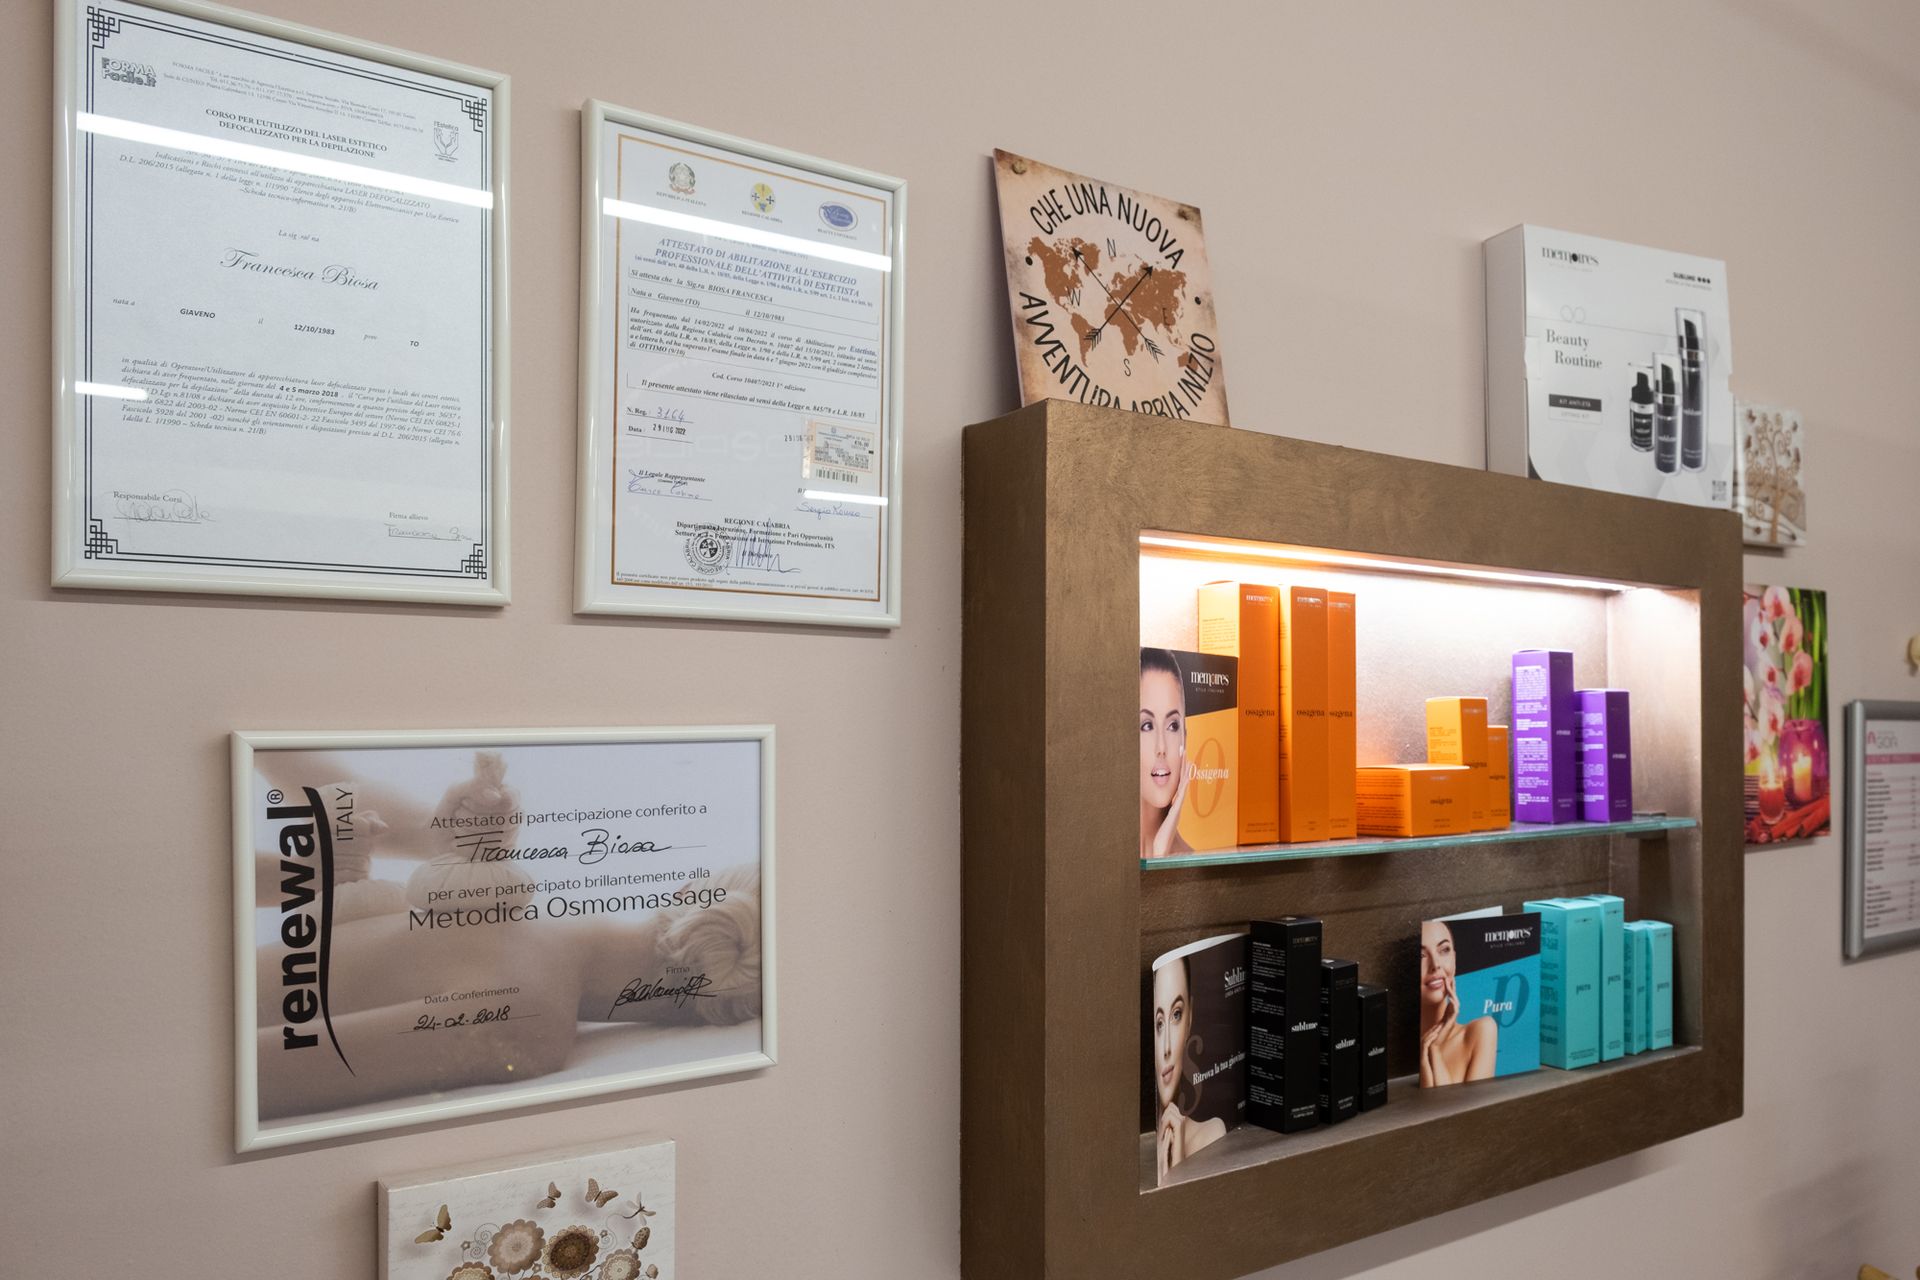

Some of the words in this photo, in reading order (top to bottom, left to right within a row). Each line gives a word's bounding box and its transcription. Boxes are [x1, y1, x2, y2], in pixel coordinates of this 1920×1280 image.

[102, 57, 156, 77] FORMA
[102, 69, 156, 87] Facile.it
[206, 109, 235, 120] CORSO
[238, 115, 253, 123] PER
[256, 119, 301, 133] L'UTILIZZO
[322, 132, 346, 142] LASER
[348, 137, 386, 150] ESTETICO
[219, 121, 288, 139] DEFOCALIZZATO
[292, 135, 306, 143] PER
[321, 141, 374, 157] DEPILAZIONE
[1030, 189, 1071, 235] CHE
[1064, 183, 1113, 218] UNA
[1117, 192, 1185, 270] NUOVA
[660, 238, 713, 255] ATTESTATO
[716, 249, 725, 258] DI
[728, 252, 790, 271] ABILITAZIONE
[1107, 238, 1117, 257] N
[220, 248, 316, 281] Francesca
[321, 264, 379, 290] Biosa
[655, 248, 732, 270] PROFESSIONALE
[804, 278, 812, 287] DI
[815, 281, 859, 296] ESTETISTA
[631, 287, 645, 295] Nata
[657, 292, 683, 302] Giaveno
[687, 280, 704, 288] Sig.ra
[708, 284, 730, 293] BIOSA
[732, 289, 772, 301] FRANCESCA
[180, 307, 216, 319] GIAVENO
[294, 323, 335, 336] 12/10/1983
[638, 342, 666, 352] OTTIMO
[1546, 328, 1589, 352] Beauty
[1123, 358, 1132, 377] S
[1554, 349, 1602, 369] Routine
[1177, 333, 1216, 408] INIZIO
[676, 385, 701, 393] attestato
[720, 391, 747, 400] rilasciato
[788, 401, 804, 410] Legge
[628, 425, 642, 433] Data
[664, 472, 706, 483] Rappresentante
[113, 490, 160, 504] Responsabile
[162, 495, 182, 504] Corsi
[389, 512, 406, 520] Firma
[724, 518, 753, 526] REGIONE
[756, 520, 790, 528] CALABRIA
[1188, 762, 1229, 784] Ossigena
[336, 787, 354, 840] ITALY
[430, 815, 505, 830] Attestato
[508, 811, 522, 825] di
[526, 806, 632, 826] partecipazione
[636, 804, 696, 818] conferito
[699, 805, 707, 814] a
[454, 830, 568, 863] Francesca
[579, 828, 672, 864] Biosa
[428, 889, 452, 904] per
[458, 886, 491, 900] aver
[496, 878, 581, 898] partecipato
[584, 870, 686, 888] brillantemente
[689, 867, 710, 880] alla
[410, 901, 538, 931] Metodica
[547, 886, 728, 918] Osmomassage
[666, 966, 690, 975] Firma
[424, 994, 448, 1004] Data
[450, 986, 520, 1002] Conferimento
[1483, 998, 1513, 1014] Pura
[1291, 1020, 1318, 1032] sublime
[1336, 1038, 1356, 1050] sublime
[1192, 1070, 1214, 1086] Ritrova
[1215, 1063, 1220, 1075] la
[1220, 1060, 1228, 1073] tua
